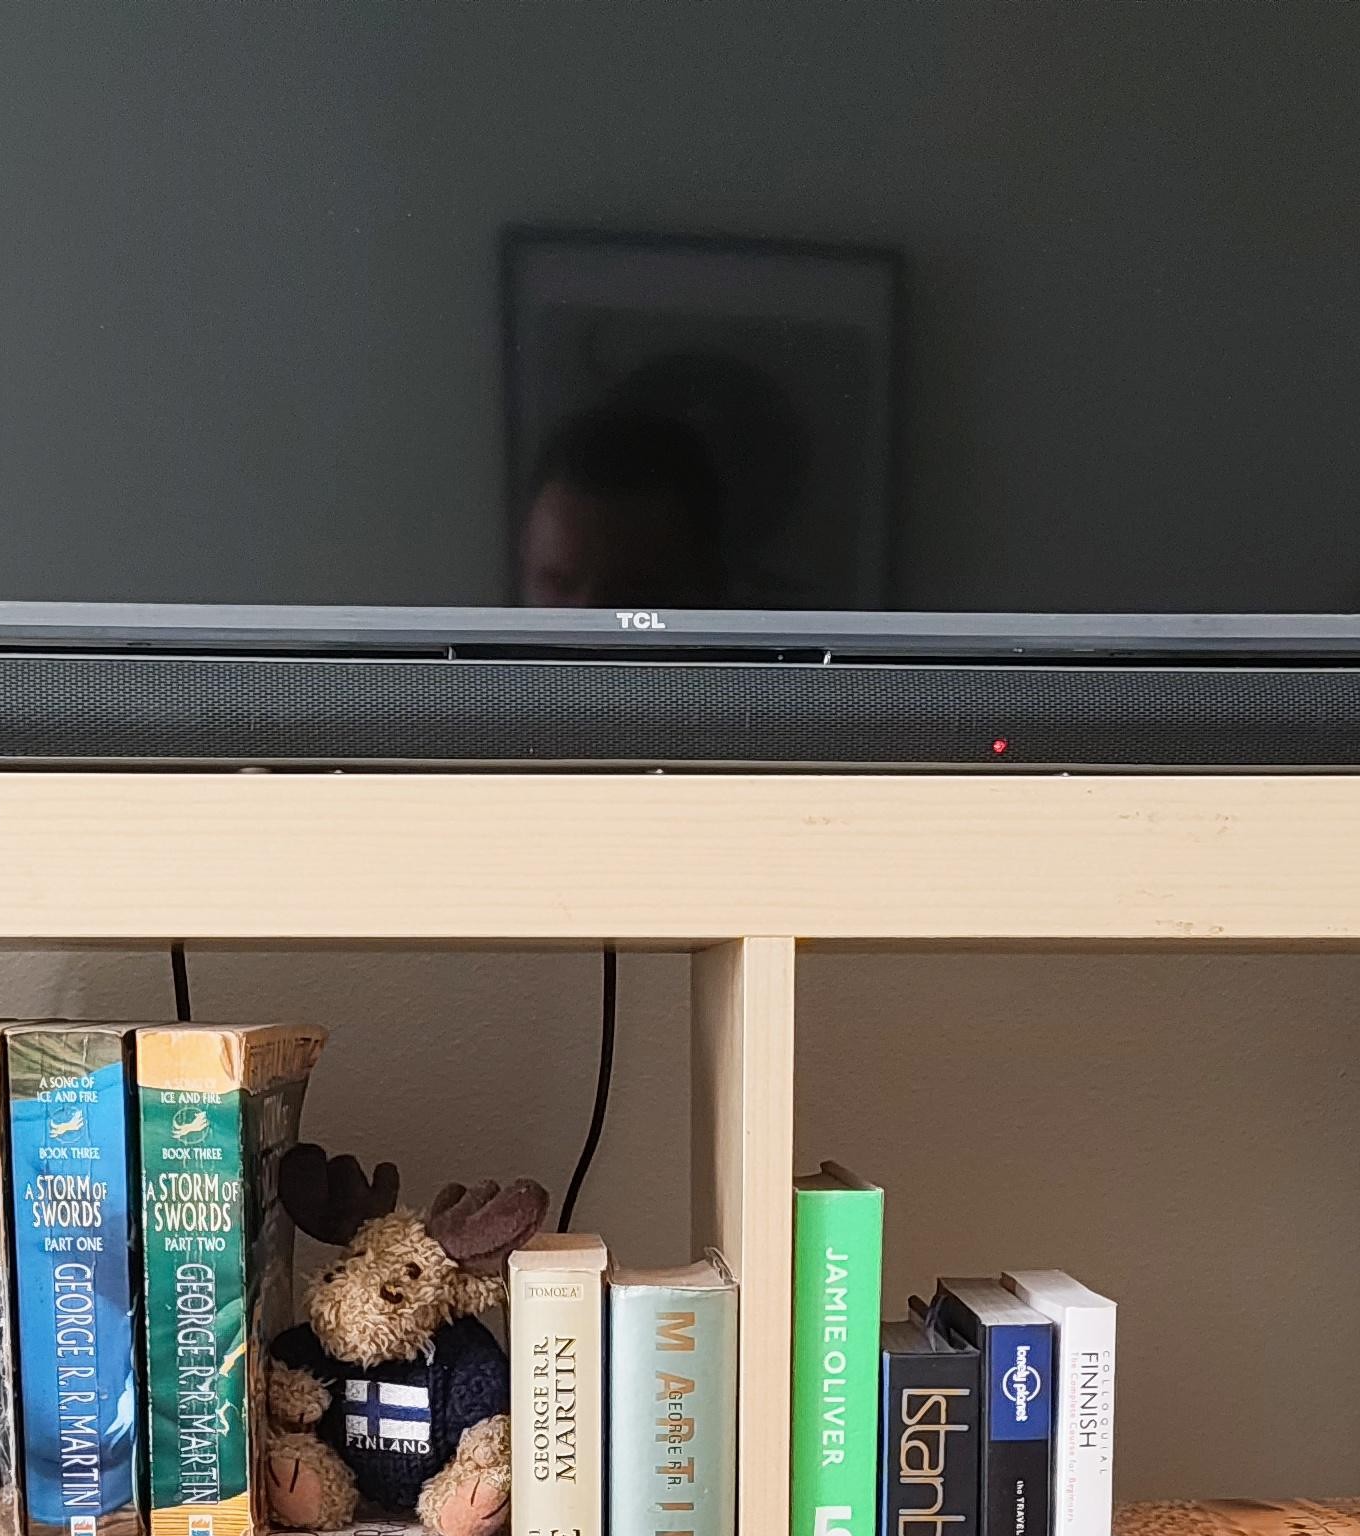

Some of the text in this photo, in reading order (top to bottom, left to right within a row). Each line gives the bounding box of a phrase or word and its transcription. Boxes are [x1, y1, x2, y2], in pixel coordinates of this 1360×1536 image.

[616, 613, 666, 629] TCL
[36, 1175, 91, 1200] STORM
[159, 1173, 218, 1201] STORM
[32, 1203, 102, 1228] SWORDS
[154, 1204, 232, 1231] SWORDS
[165, 1238, 226, 1252] PART TWO
[821, 1247, 850, 1467] JAMIE OLIVER
[555, 1336, 578, 1484] MARTIN
[1080, 1351, 1098, 1451] FINNISH
[536, 1386, 551, 1482] GEORGE
